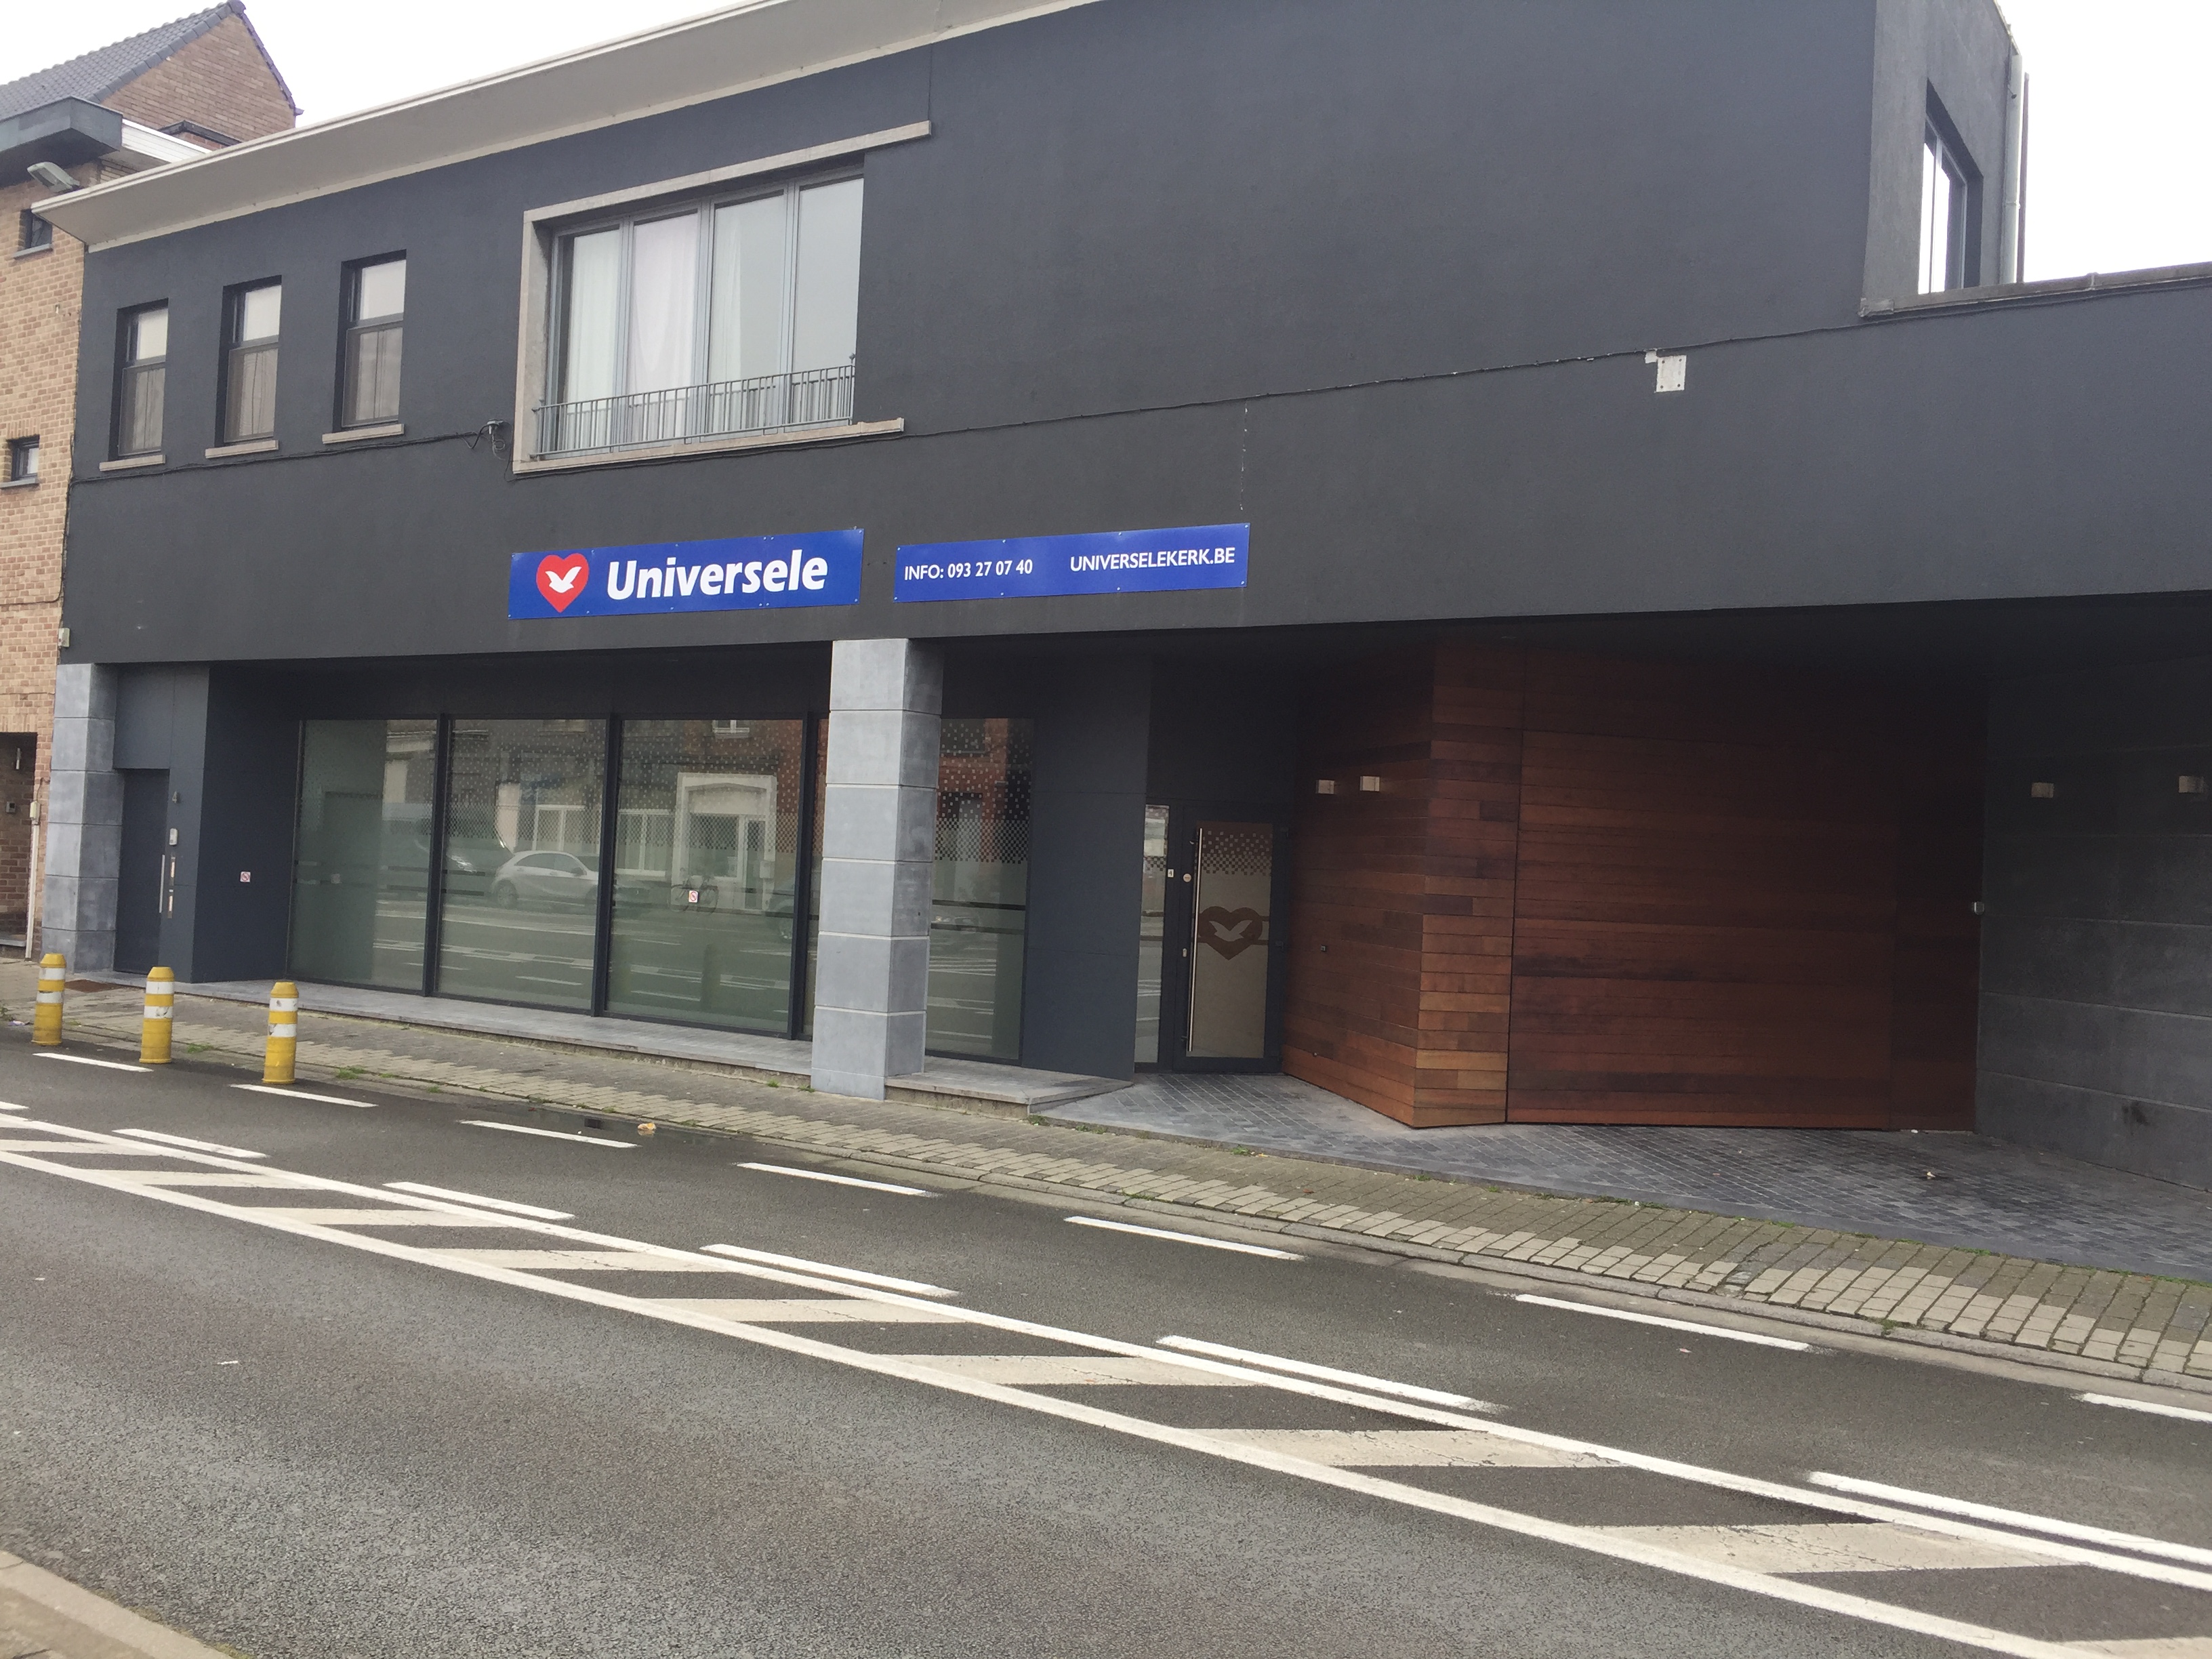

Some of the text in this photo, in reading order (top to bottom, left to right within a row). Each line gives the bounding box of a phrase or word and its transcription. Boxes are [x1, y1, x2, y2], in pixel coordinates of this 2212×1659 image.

[607, 549, 828, 600] Universele
[904, 547, 1235, 581] INFO: 093 27 07 40 UNIVERSELEKERK.BE
